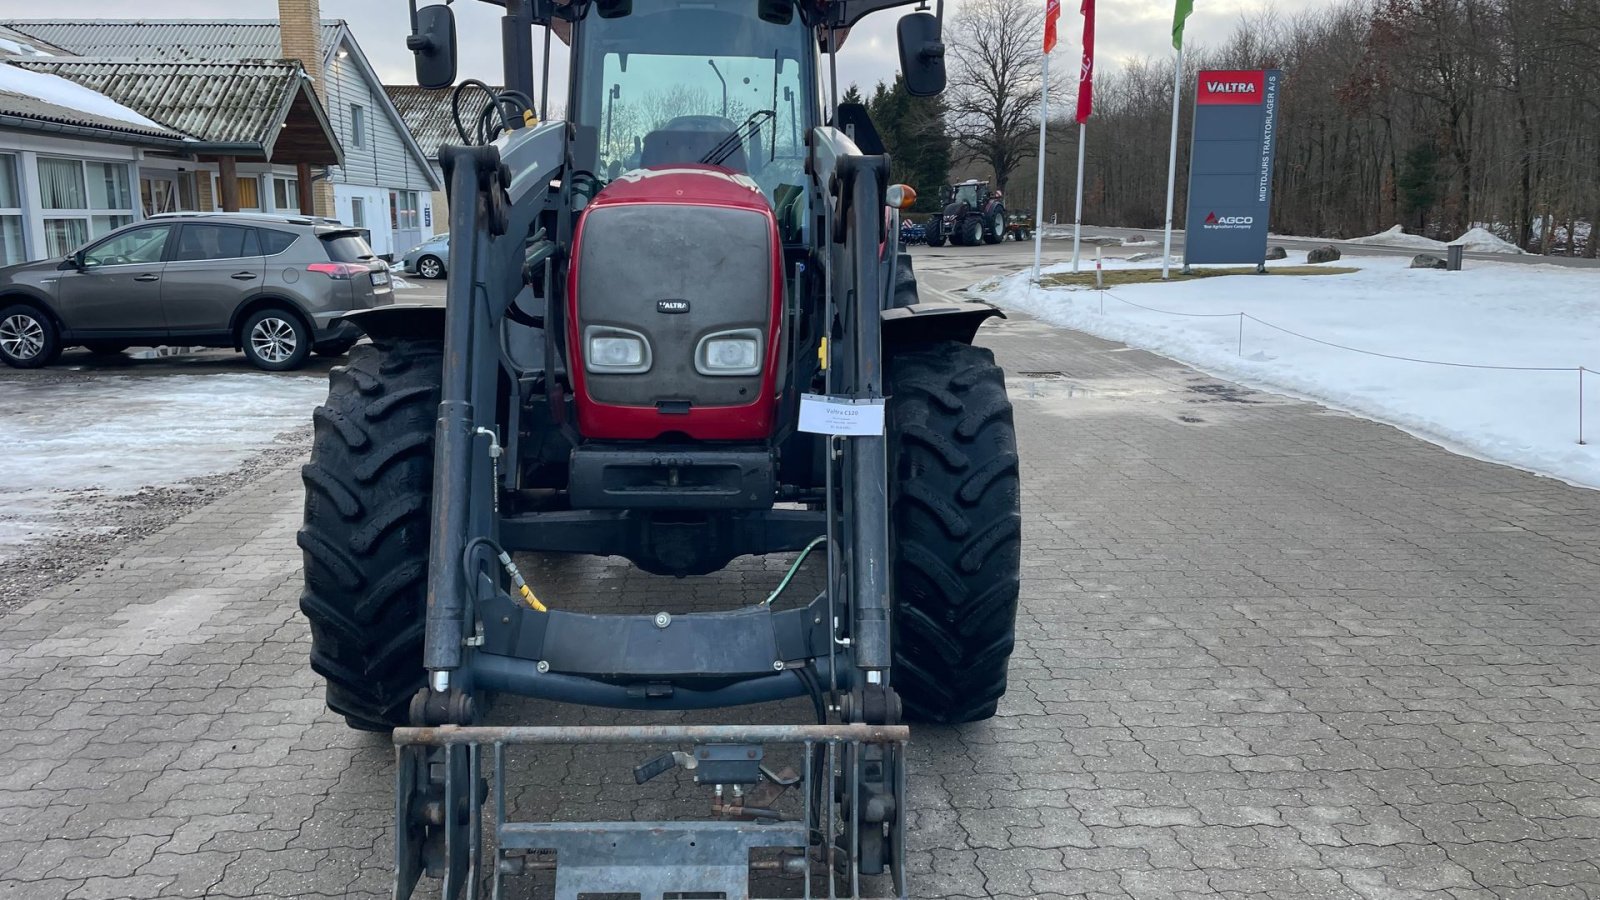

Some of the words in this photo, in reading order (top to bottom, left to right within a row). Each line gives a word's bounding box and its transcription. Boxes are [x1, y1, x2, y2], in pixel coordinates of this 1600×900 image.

[1207, 81, 1256, 93] VALTRA
[1268, 75, 1277, 91] A/S
[1263, 92, 1275, 155] TRAKTORLAGER
[1259, 156, 1270, 202] MIDTDJURS
[1217, 216, 1253, 224] AGCO
[826, 408, 844, 416] Valtra
[844, 409, 860, 417] C120
